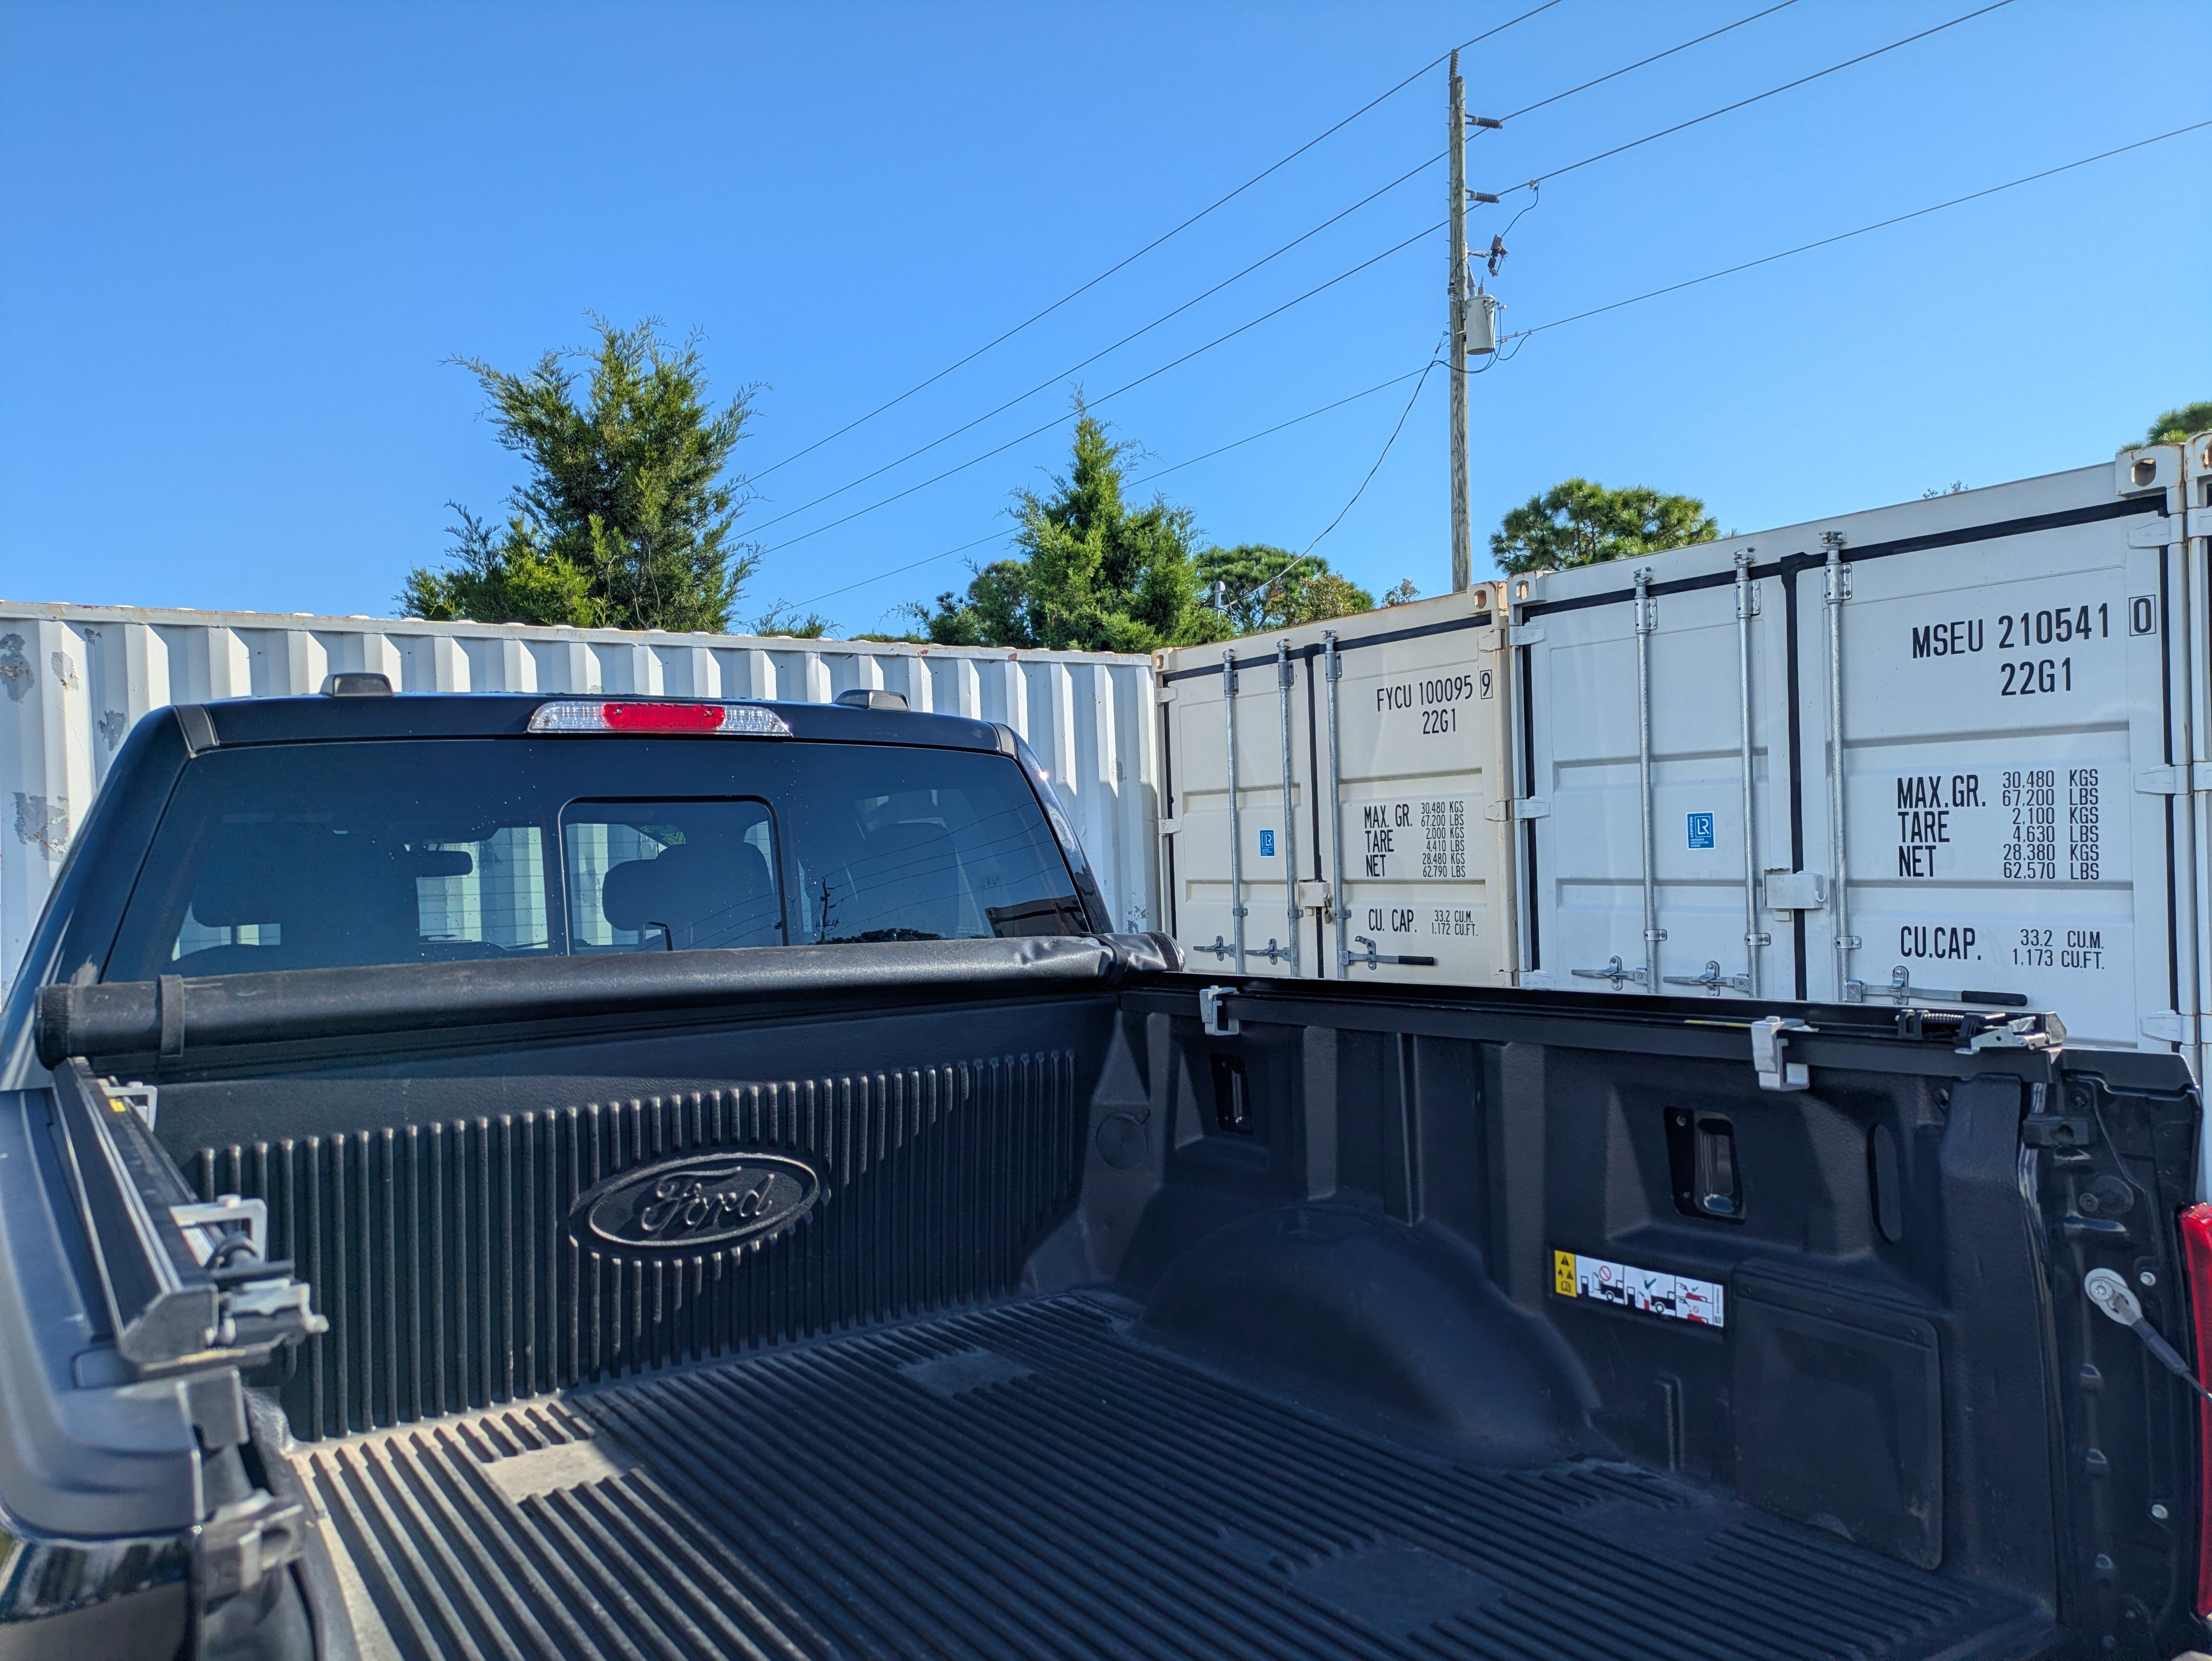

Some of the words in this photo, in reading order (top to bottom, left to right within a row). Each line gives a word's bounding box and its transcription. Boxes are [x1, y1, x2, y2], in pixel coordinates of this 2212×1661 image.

[1912, 619, 1983, 659] MSEU
[1998, 602, 2108, 649] 210541
[2133, 598, 2152, 633] 0
[2000, 657, 2071, 696] 22G1
[1377, 684, 1412, 712] FYCU
[1419, 675, 1473, 706] 100095
[1482, 672, 1491, 697] 9
[1422, 708, 1456, 735] 22G1
[2069, 768, 2098, 787] KGS
[2069, 787, 2099, 806] LBS
[1364, 805, 1390, 829] MAX.
[1395, 803, 1413, 827] GR.
[1449, 800, 1464, 813] KGS
[1449, 813, 1464, 826] LBS
[1897, 810, 1950, 843] TARE
[2069, 806, 2099, 824] KGS
[1365, 829, 1394, 853] TARE
[1450, 826, 1464, 839] KGS
[1450, 839, 1465, 852] LBS
[2069, 825, 2099, 843] LBS
[1365, 854, 1386, 877] NET
[1450, 852, 1465, 865] KGS
[1451, 865, 1466, 878] LBS
[1898, 845, 1937, 877] NET
[2070, 843, 2099, 862] KGS
[2070, 862, 2099, 880] LBS
[1368, 908, 1385, 931] CU.
[1392, 908, 1417, 933] CAP.
[1434, 909, 1450, 922] 33.2
[1454, 910, 1473, 923] CU.M.
[1454, 923, 1478, 936] CU.FT.
[2020, 929, 2053, 947] 33.2
[2067, 930, 2104, 949] CU.M.
[2061, 950, 2104, 970] CU.FT.
[641, 1165, 774, 1233] Ford
